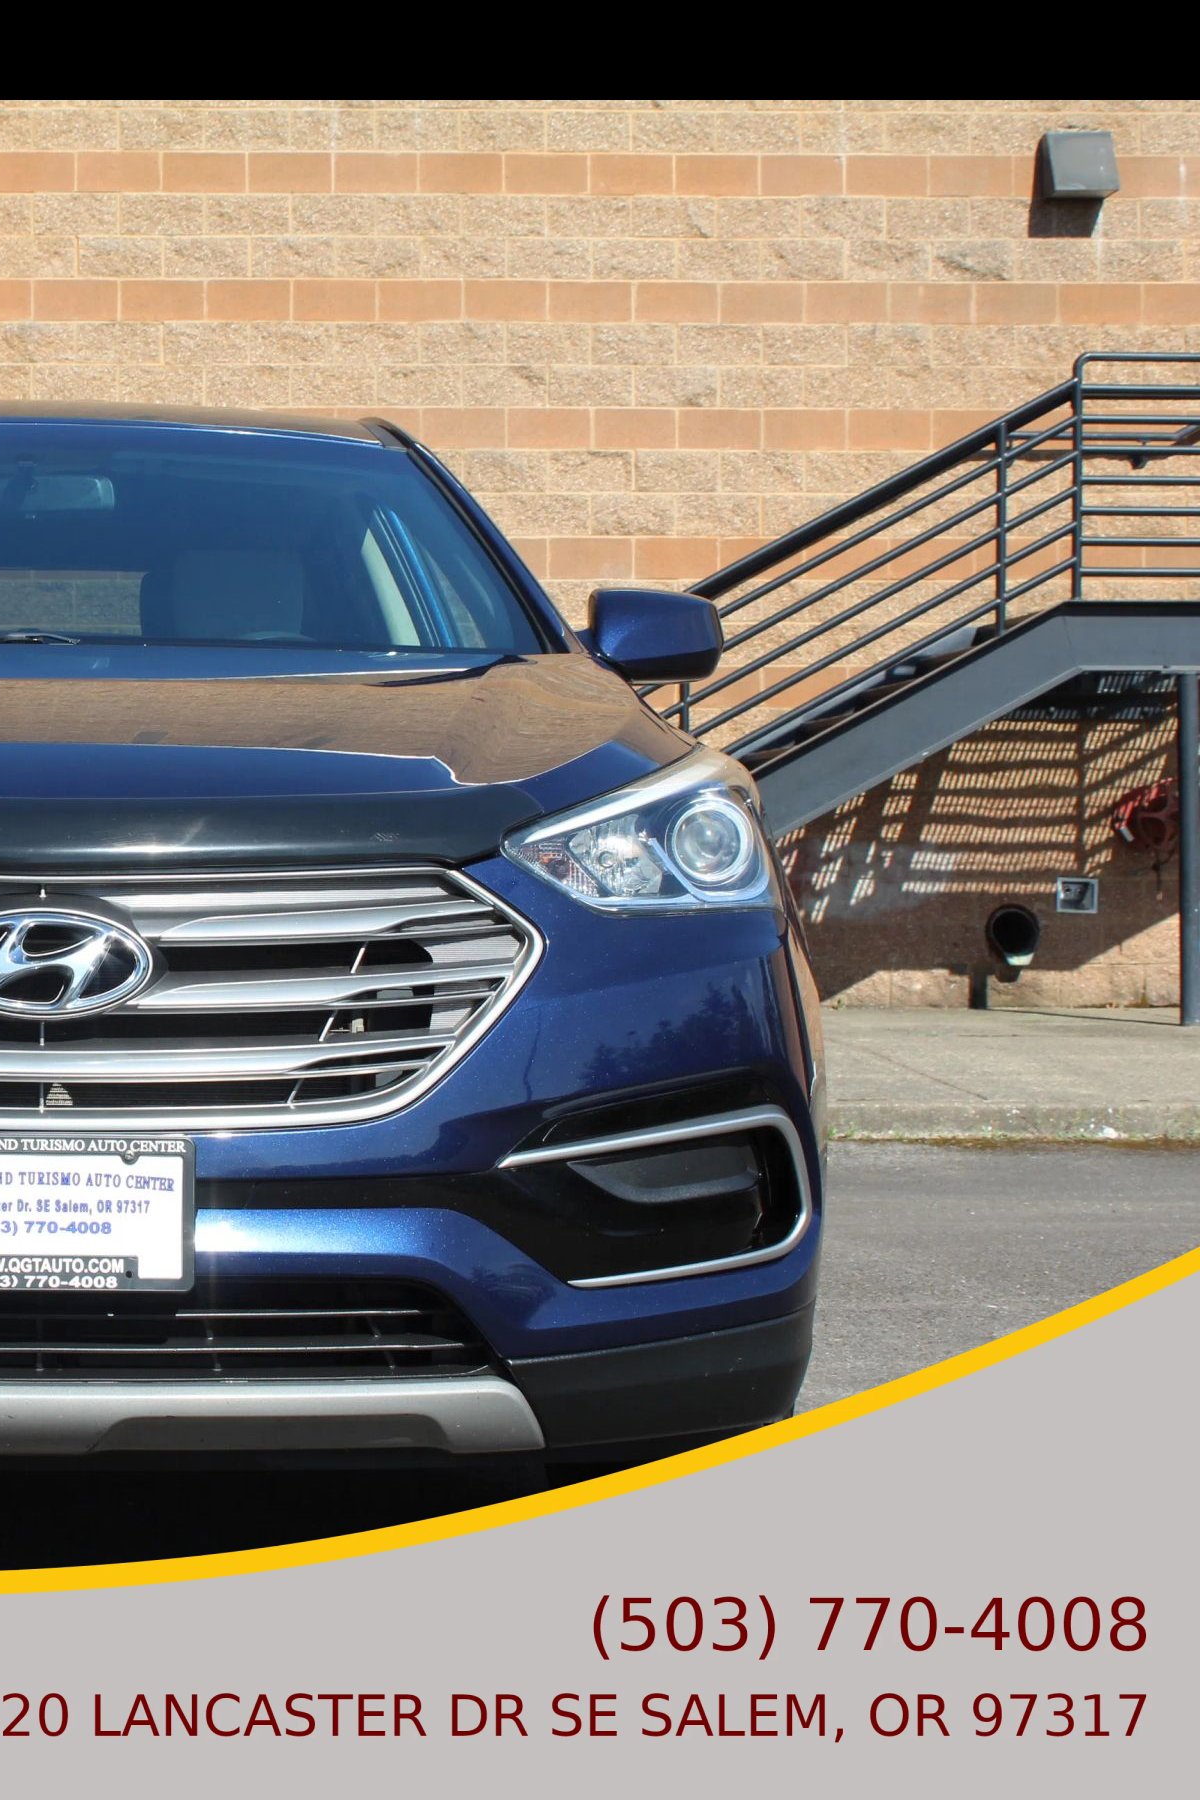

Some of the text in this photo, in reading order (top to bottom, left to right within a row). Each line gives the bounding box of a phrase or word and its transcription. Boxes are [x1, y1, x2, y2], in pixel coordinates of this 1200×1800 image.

[21, 1138, 86, 1152] TURISMO
[87, 1139, 128, 1152] AUTO
[129, 1140, 187, 1153] CENTER
[18, 1171, 81, 1186] TURISMO
[85, 1173, 121, 1188] AUTO
[125, 1175, 175, 1192] CENTER
[17, 1199, 32, 1213] Dr.
[36, 1199, 50, 1213] SE
[55, 1200, 93, 1216] Salem,
[97, 1200, 112, 1213] OR
[116, 1200, 151, 1214] 97317
[24, 1221, 112, 1235] 770-4008
[24, 1275, 119, 1289] 770-4008
